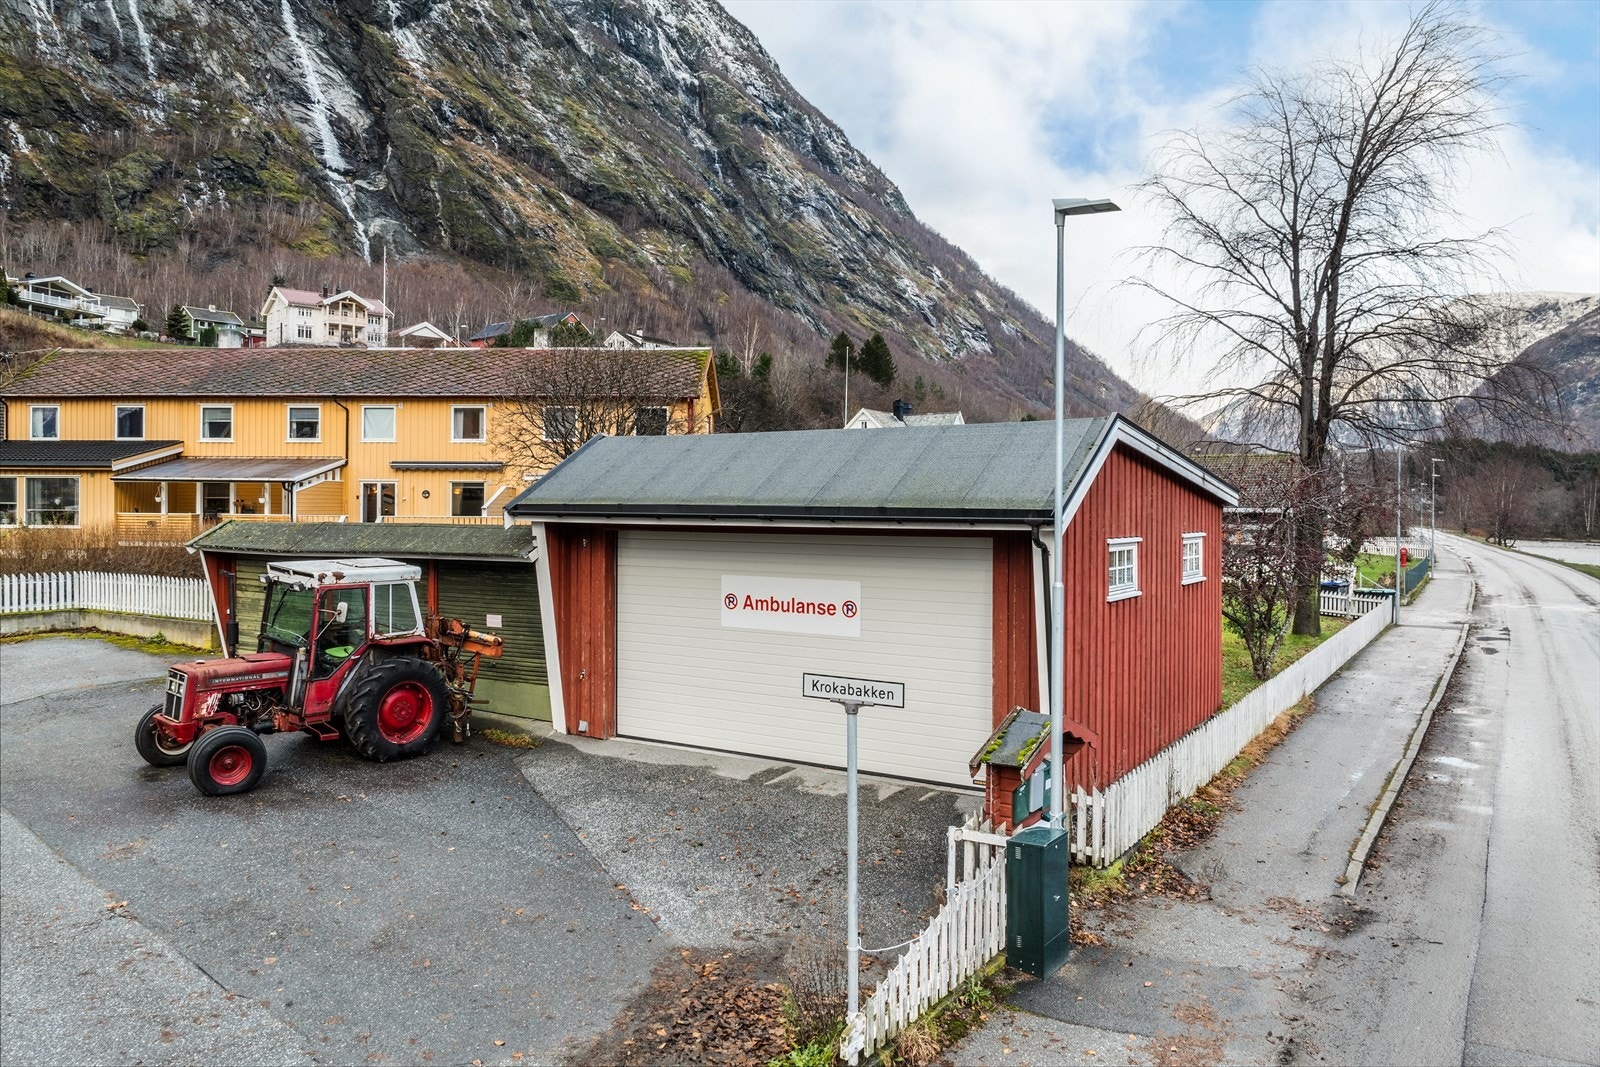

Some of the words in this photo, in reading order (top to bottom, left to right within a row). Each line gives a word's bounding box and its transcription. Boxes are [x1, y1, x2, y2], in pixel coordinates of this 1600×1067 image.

[743, 595, 837, 616] Ambulanse
[212, 675, 260, 684] INTERNATIONAL
[812, 680, 894, 701] Krokabakken
